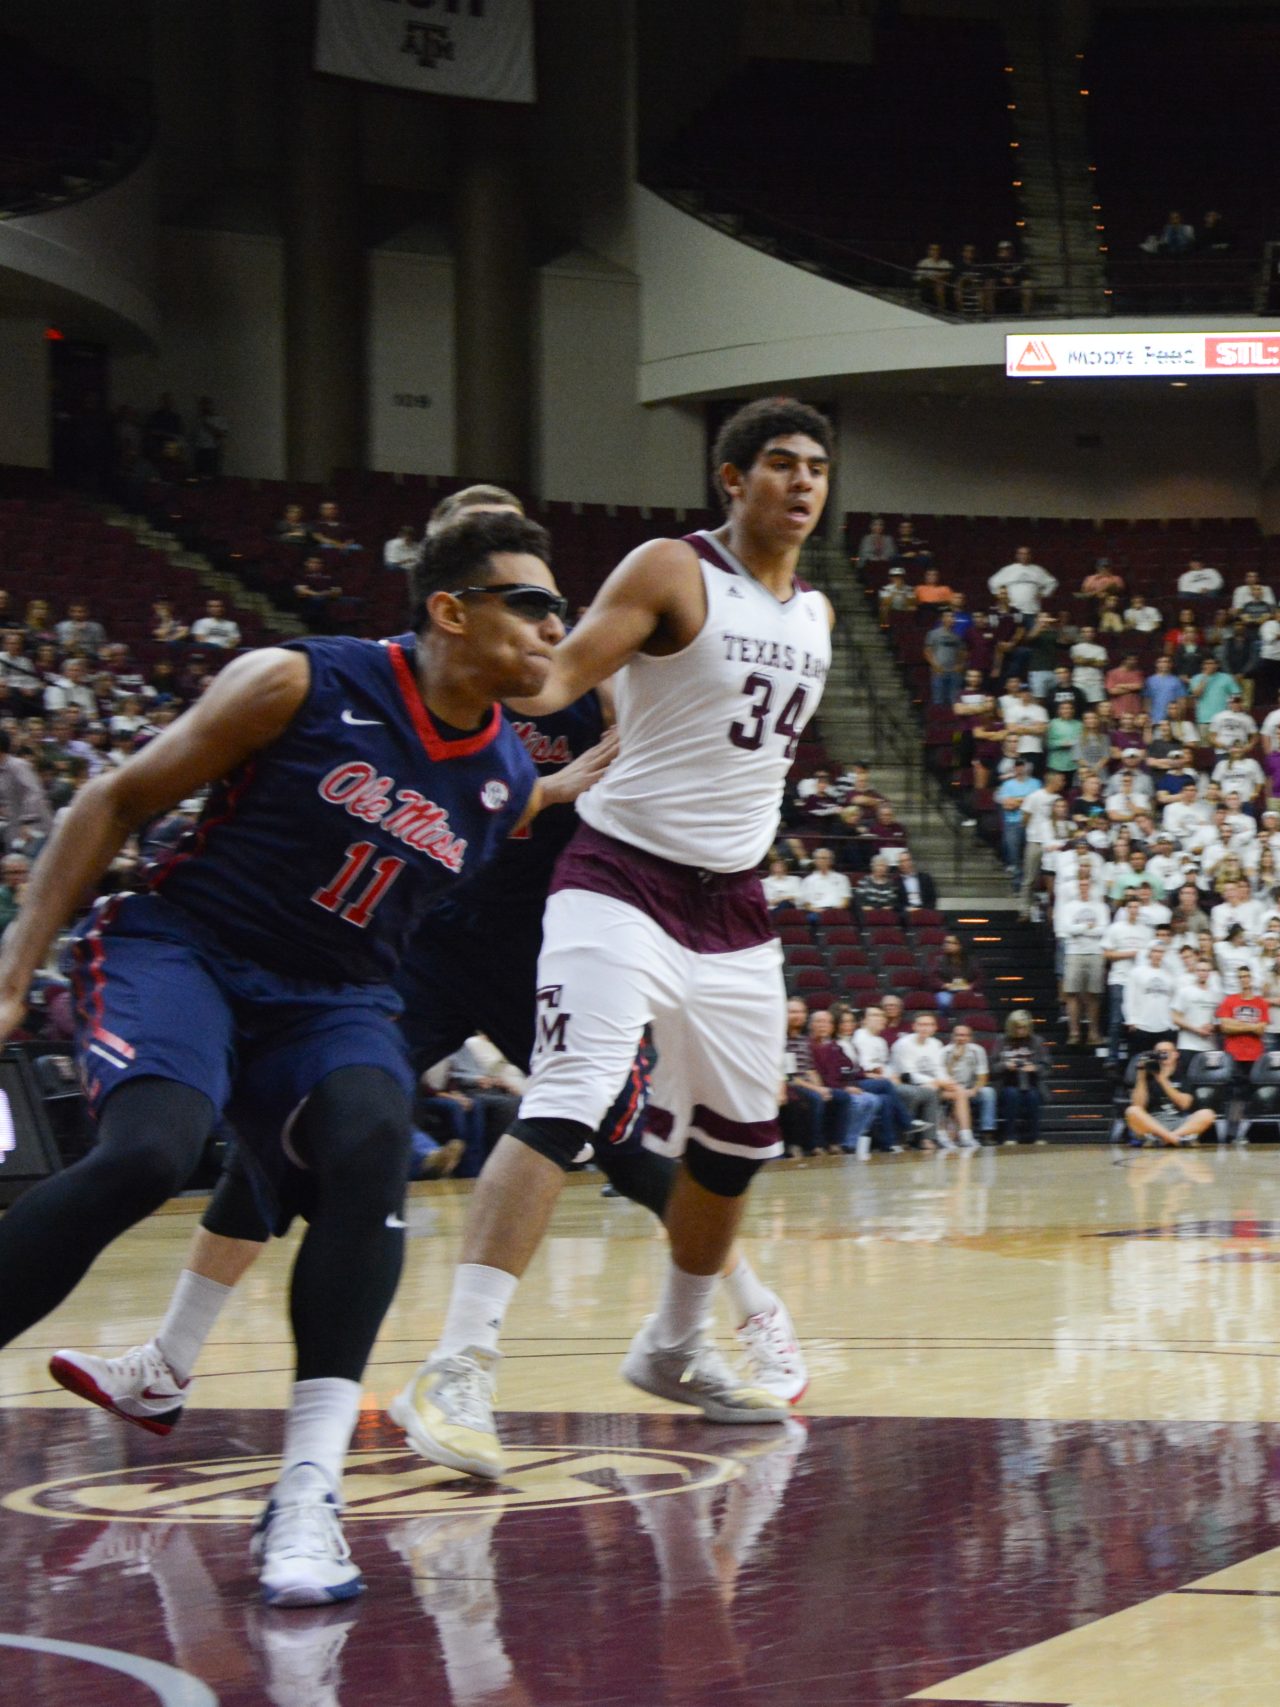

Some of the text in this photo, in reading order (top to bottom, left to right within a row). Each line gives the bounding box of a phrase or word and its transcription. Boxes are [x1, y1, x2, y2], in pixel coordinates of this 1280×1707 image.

[1215, 341, 1280, 366] STL:
[722, 634, 796, 671] TEXAS
[728, 671, 812, 760] 34
[318, 761, 395, 823] Ole
[381, 789, 469, 874] Miss
[310, 840, 408, 928] 11
